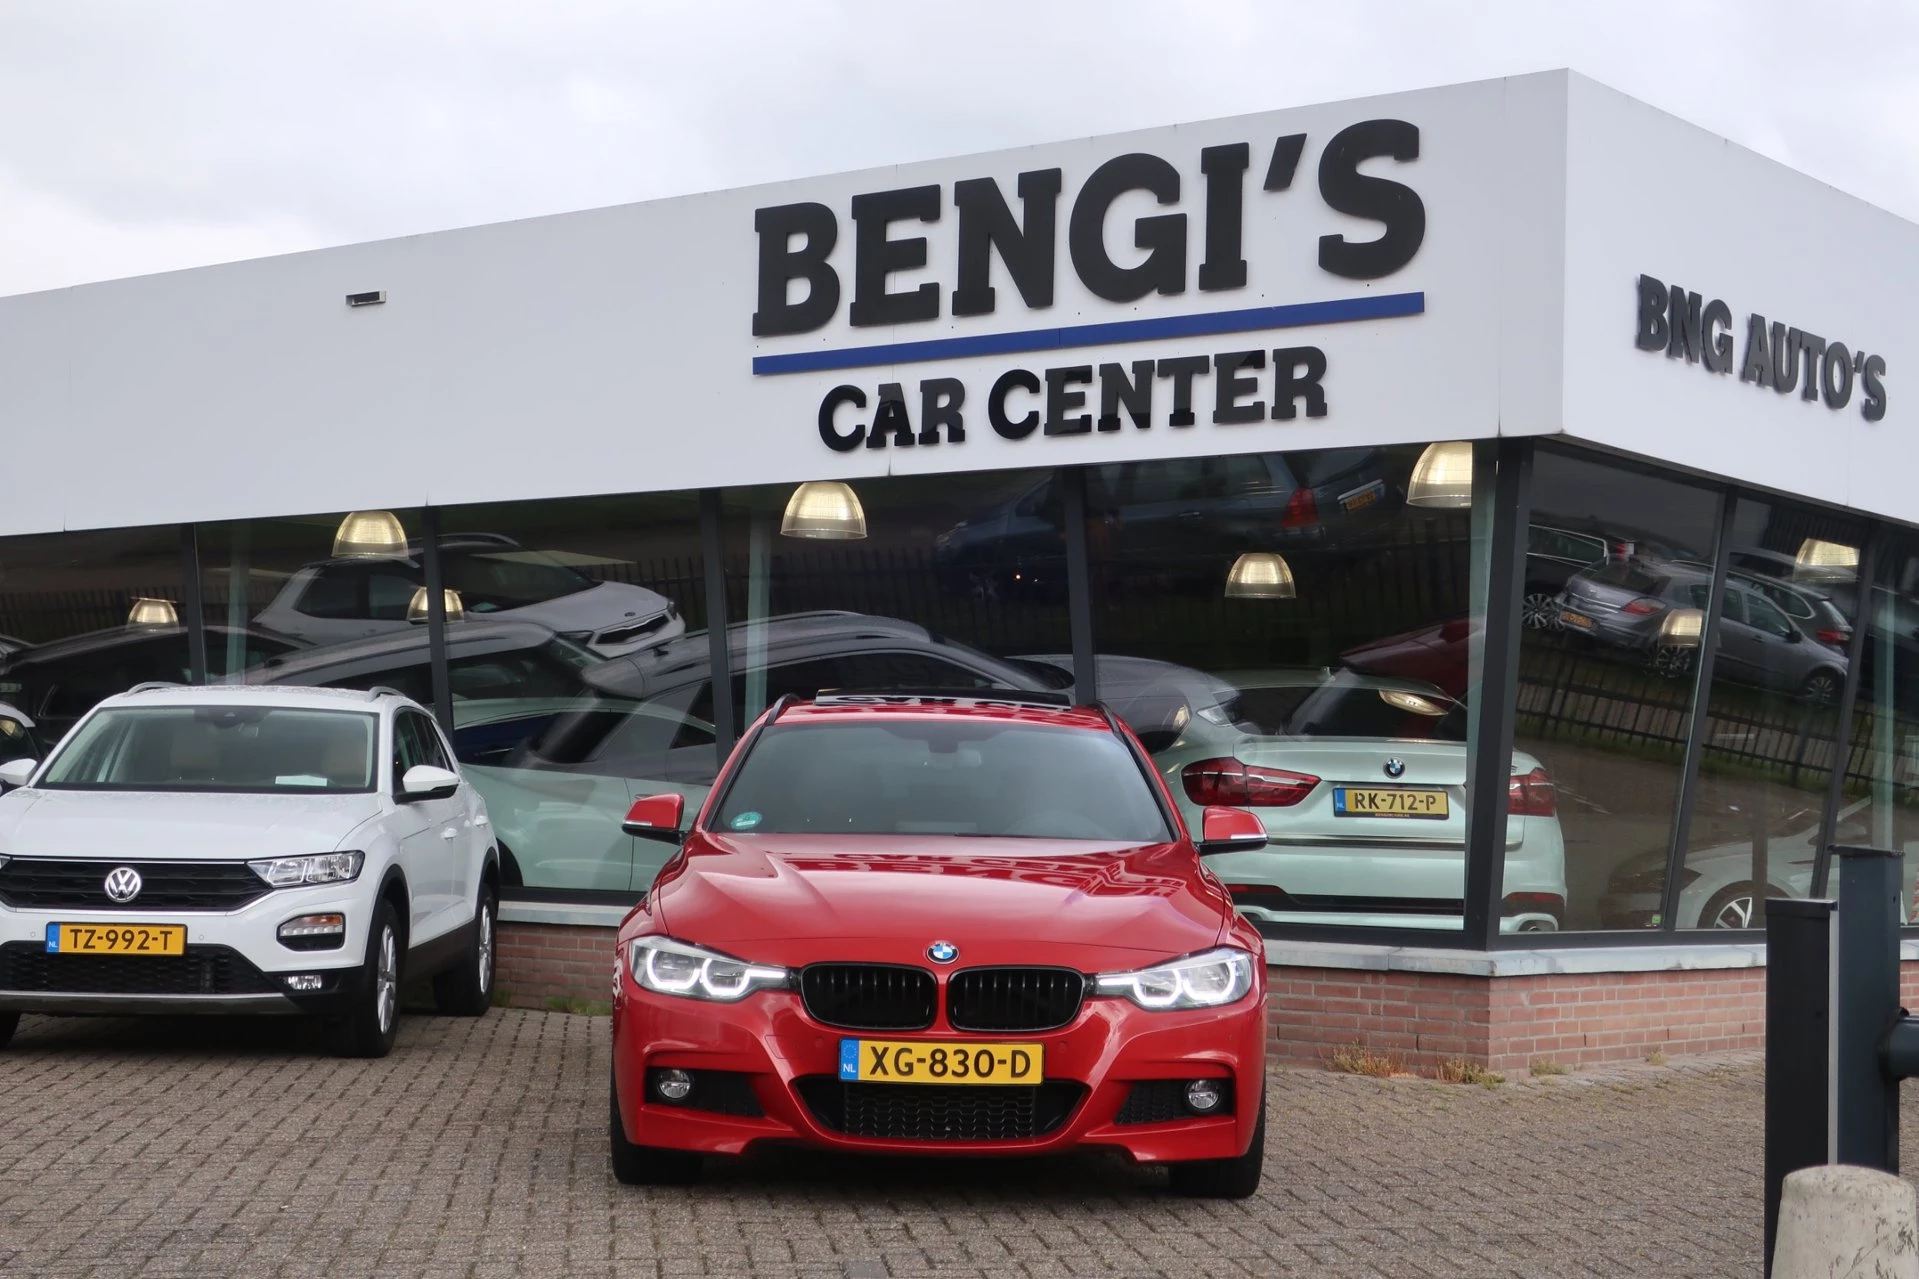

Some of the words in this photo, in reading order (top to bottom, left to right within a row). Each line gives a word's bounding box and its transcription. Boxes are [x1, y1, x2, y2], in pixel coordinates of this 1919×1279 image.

[752, 118, 1426, 337] BENGI'S
[1636, 273, 1734, 375] BNG
[1741, 312, 1888, 422] AUTO'S
[818, 376, 966, 452] CAR
[987, 345, 1328, 440] CENTER
[1354, 792, 1437, 811] RK-712-P
[48, 941, 58, 949] NL
[69, 928, 173, 951] TZ-992-T
[842, 1063, 857, 1073] NL
[869, 1045, 1031, 1079] XG-830-D
